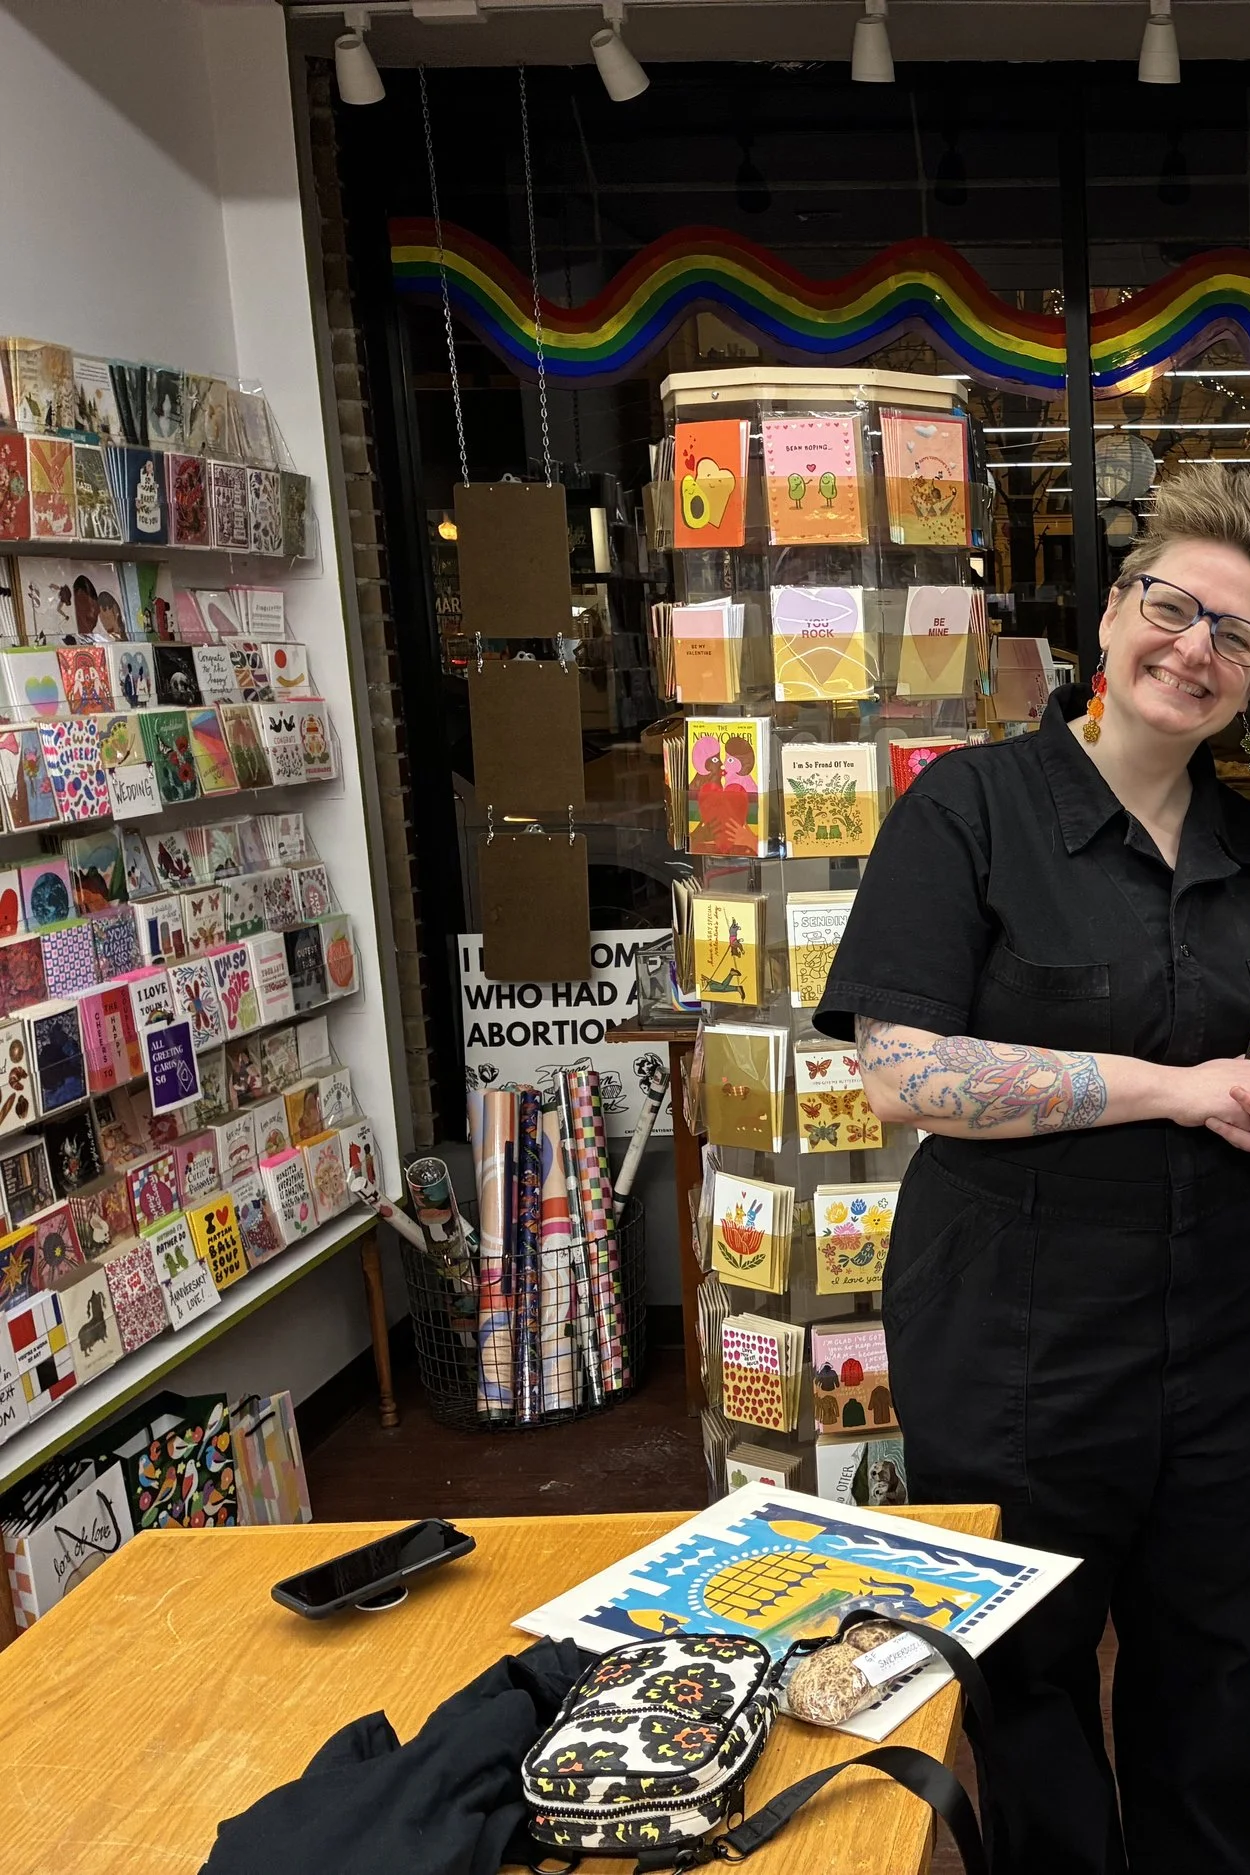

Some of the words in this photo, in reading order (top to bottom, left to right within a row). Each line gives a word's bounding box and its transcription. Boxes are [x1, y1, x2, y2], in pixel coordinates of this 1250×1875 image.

[928, 627, 948, 636] MINE
[933, 618, 945, 627] BE
[802, 629, 834, 638] ROCK
[60, 747, 98, 765] CHEERS!
[113, 778, 154, 805] WEDDING
[137, 990, 142, 1002] I
[144, 983, 168, 999] LOVE
[464, 984, 542, 1009] WHO
[552, 982, 617, 1007] HAD
[151, 1040, 165, 1051] ALL
[153, 1045, 183, 1062] GREETING
[154, 1061, 177, 1073] CARDS
[204, 1212, 215, 1234] I
[156, 1237, 177, 1255] RATHER
[178, 1232, 187, 1243] DO
[209, 1237, 236, 1258] BALL
[213, 1248, 238, 1272] SOUP
[843, 1275, 864, 1284] love
[170, 1273, 207, 1305] ANNIVERSARY
[178, 1305, 183, 1319] &
[868, 1334, 883, 1342] GOT
[3, 1370, 11, 1381] in
[836, 1465, 854, 1491] OTTER
[74, 1528, 88, 1557] of
[91, 1513, 111, 1549] love
